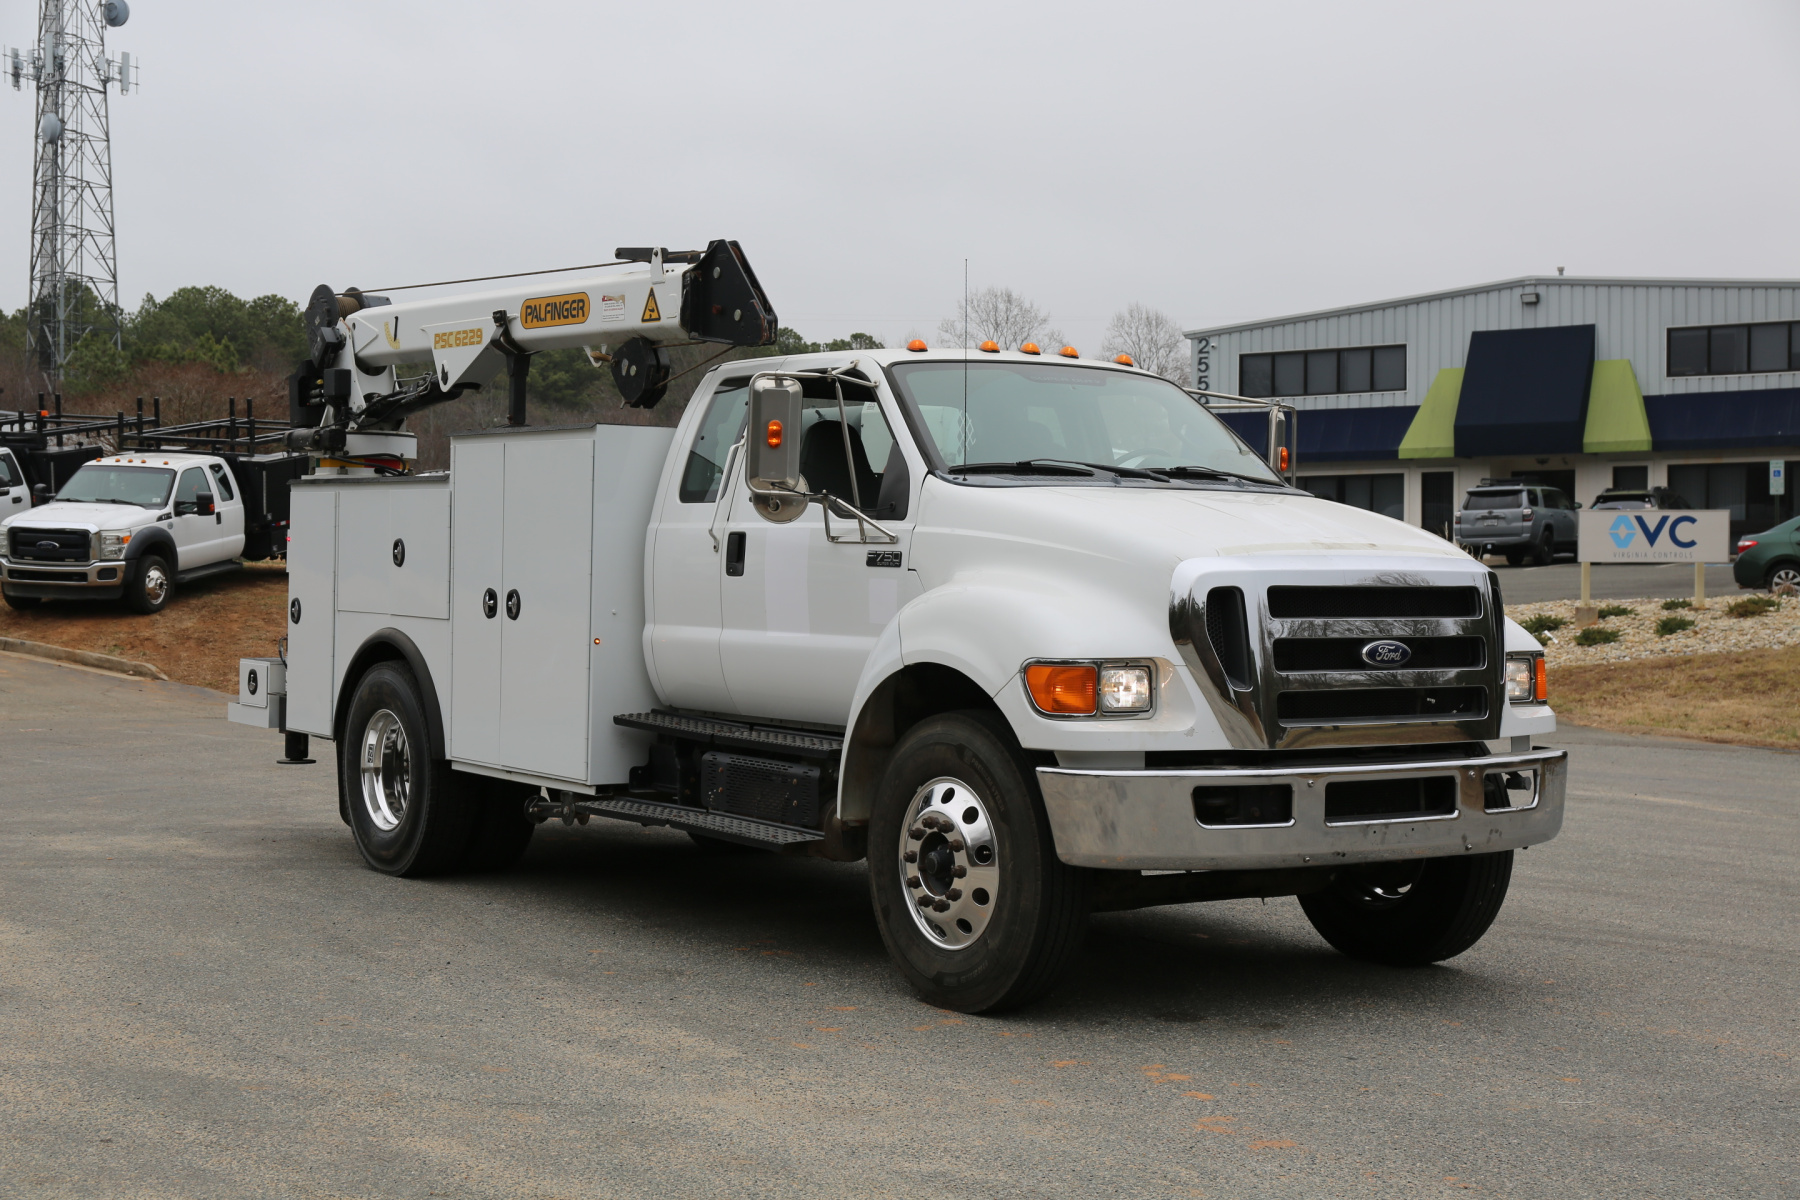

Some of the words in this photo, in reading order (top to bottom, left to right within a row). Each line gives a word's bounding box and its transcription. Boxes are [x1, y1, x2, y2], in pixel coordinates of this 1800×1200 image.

[525, 298, 586, 324] PALFINGER
[434, 331, 454, 350] PSC
[454, 328, 483, 347] 6229
[1634, 515, 1698, 548] VC
[1613, 551, 1648, 559] VIRGINIA
[1652, 551, 1693, 559] CONTROLS
[1375, 645, 1402, 661] Ford
